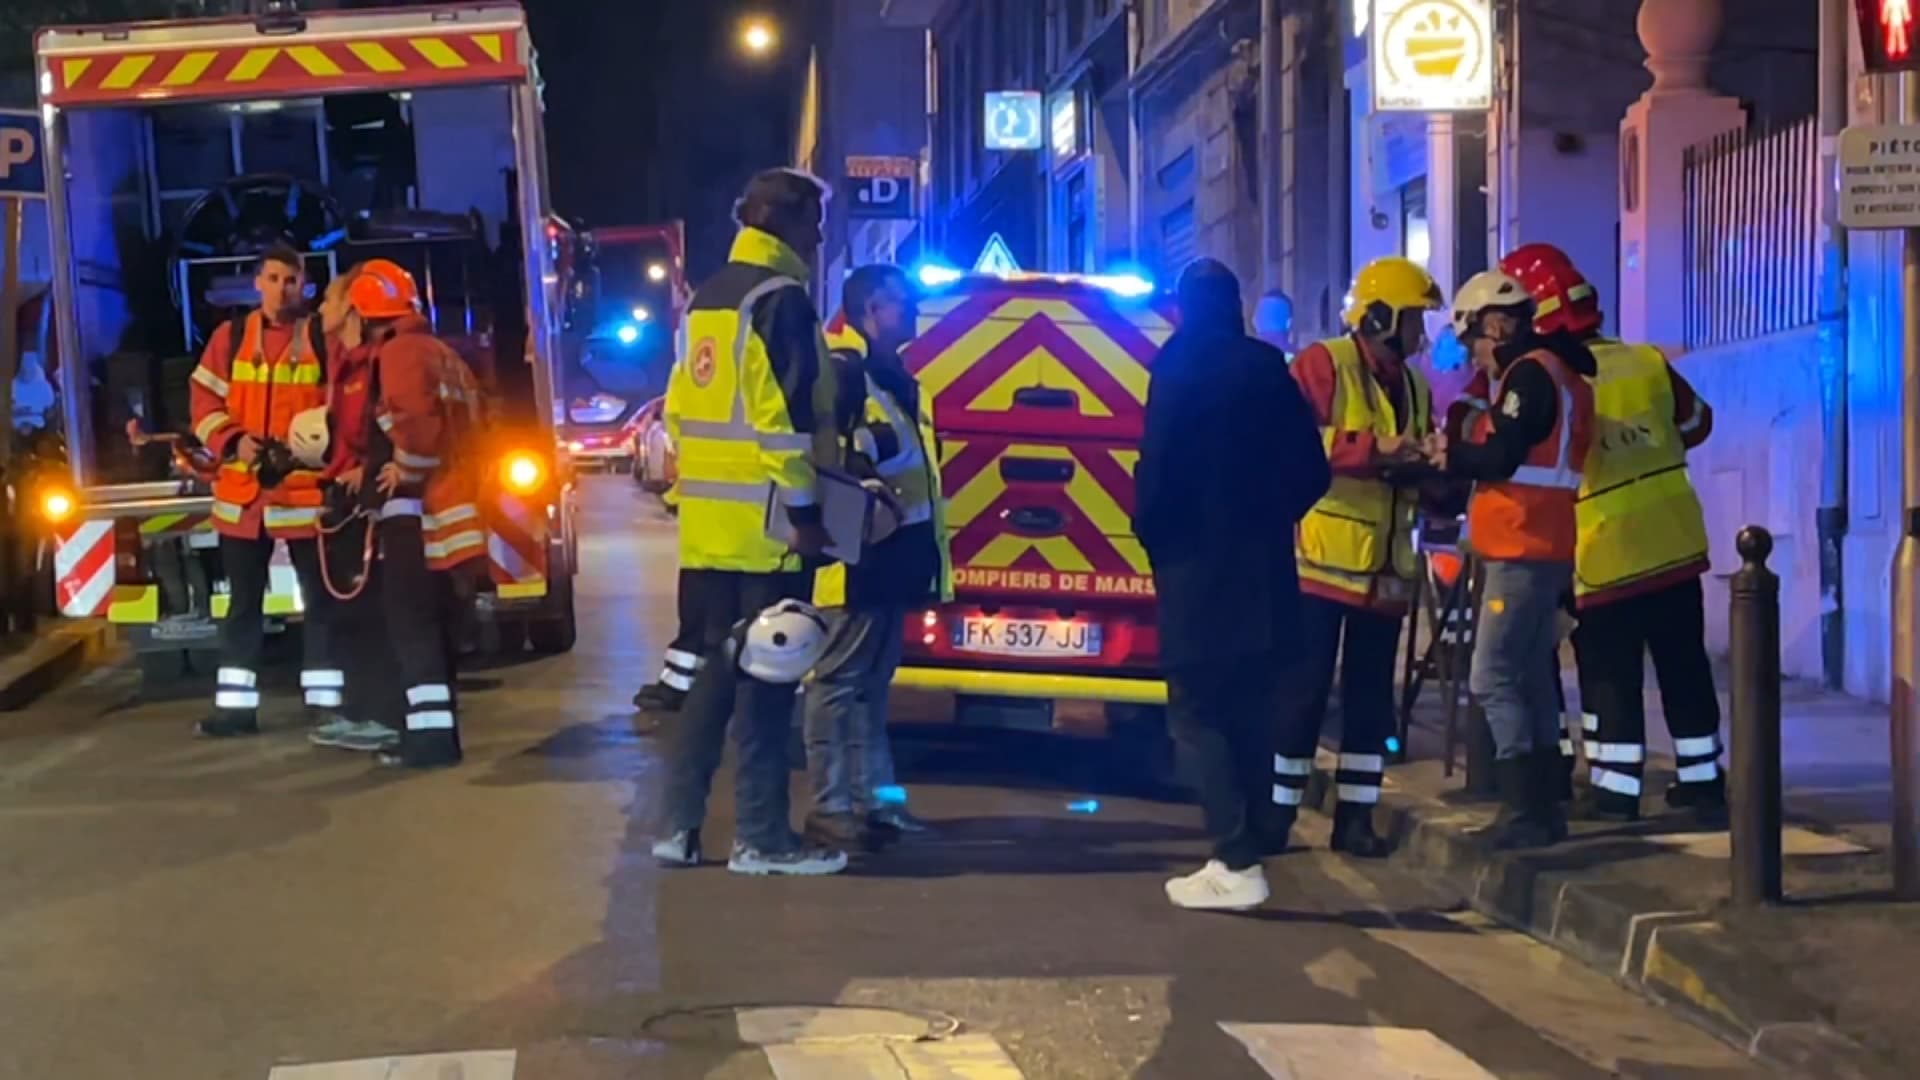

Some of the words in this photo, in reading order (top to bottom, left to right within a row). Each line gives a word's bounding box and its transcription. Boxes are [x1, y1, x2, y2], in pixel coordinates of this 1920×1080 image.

[0, 128, 34, 177] P
[952, 568, 1051, 590] OMPIERS
[1059, 575, 1088, 592] DE
